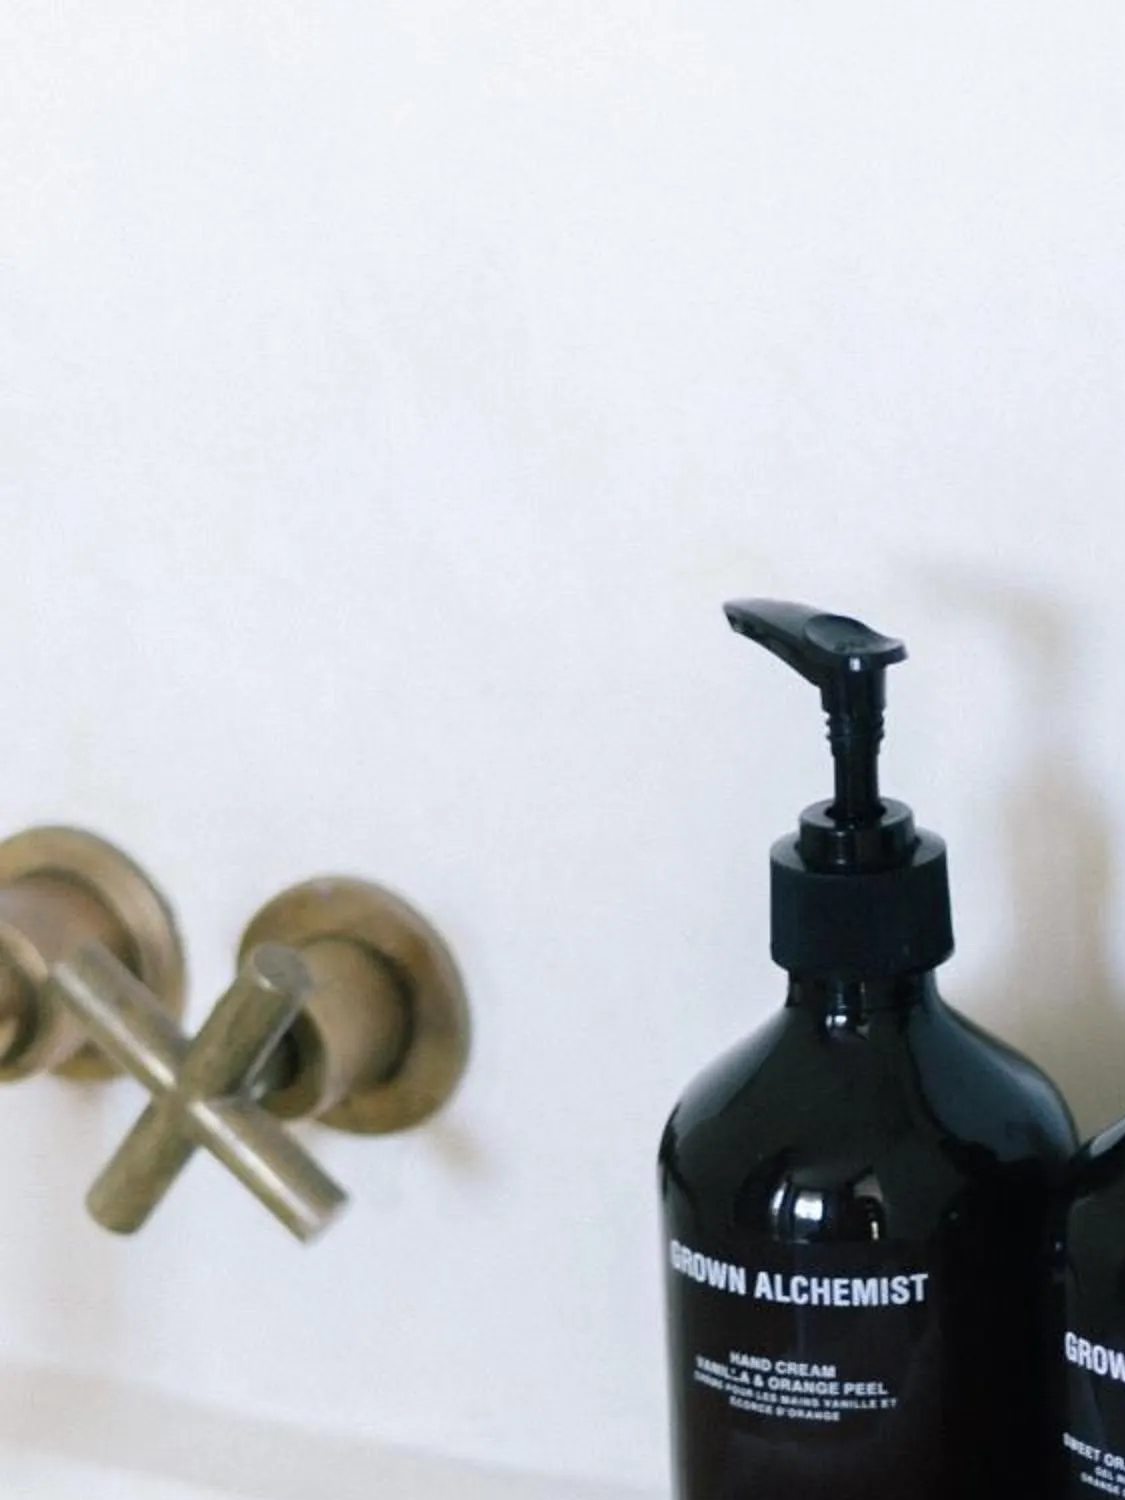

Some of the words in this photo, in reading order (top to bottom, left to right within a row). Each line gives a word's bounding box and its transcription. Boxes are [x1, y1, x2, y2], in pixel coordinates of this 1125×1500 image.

[670, 1239, 747, 1296] GROWN
[754, 1271, 929, 1307] ALCHEMIST
[729, 1351, 772, 1373] HAND
[775, 1361, 837, 1380] CREAM
[767, 1376, 841, 1396] ORANGE
[843, 1381, 889, 1396] PEEL
